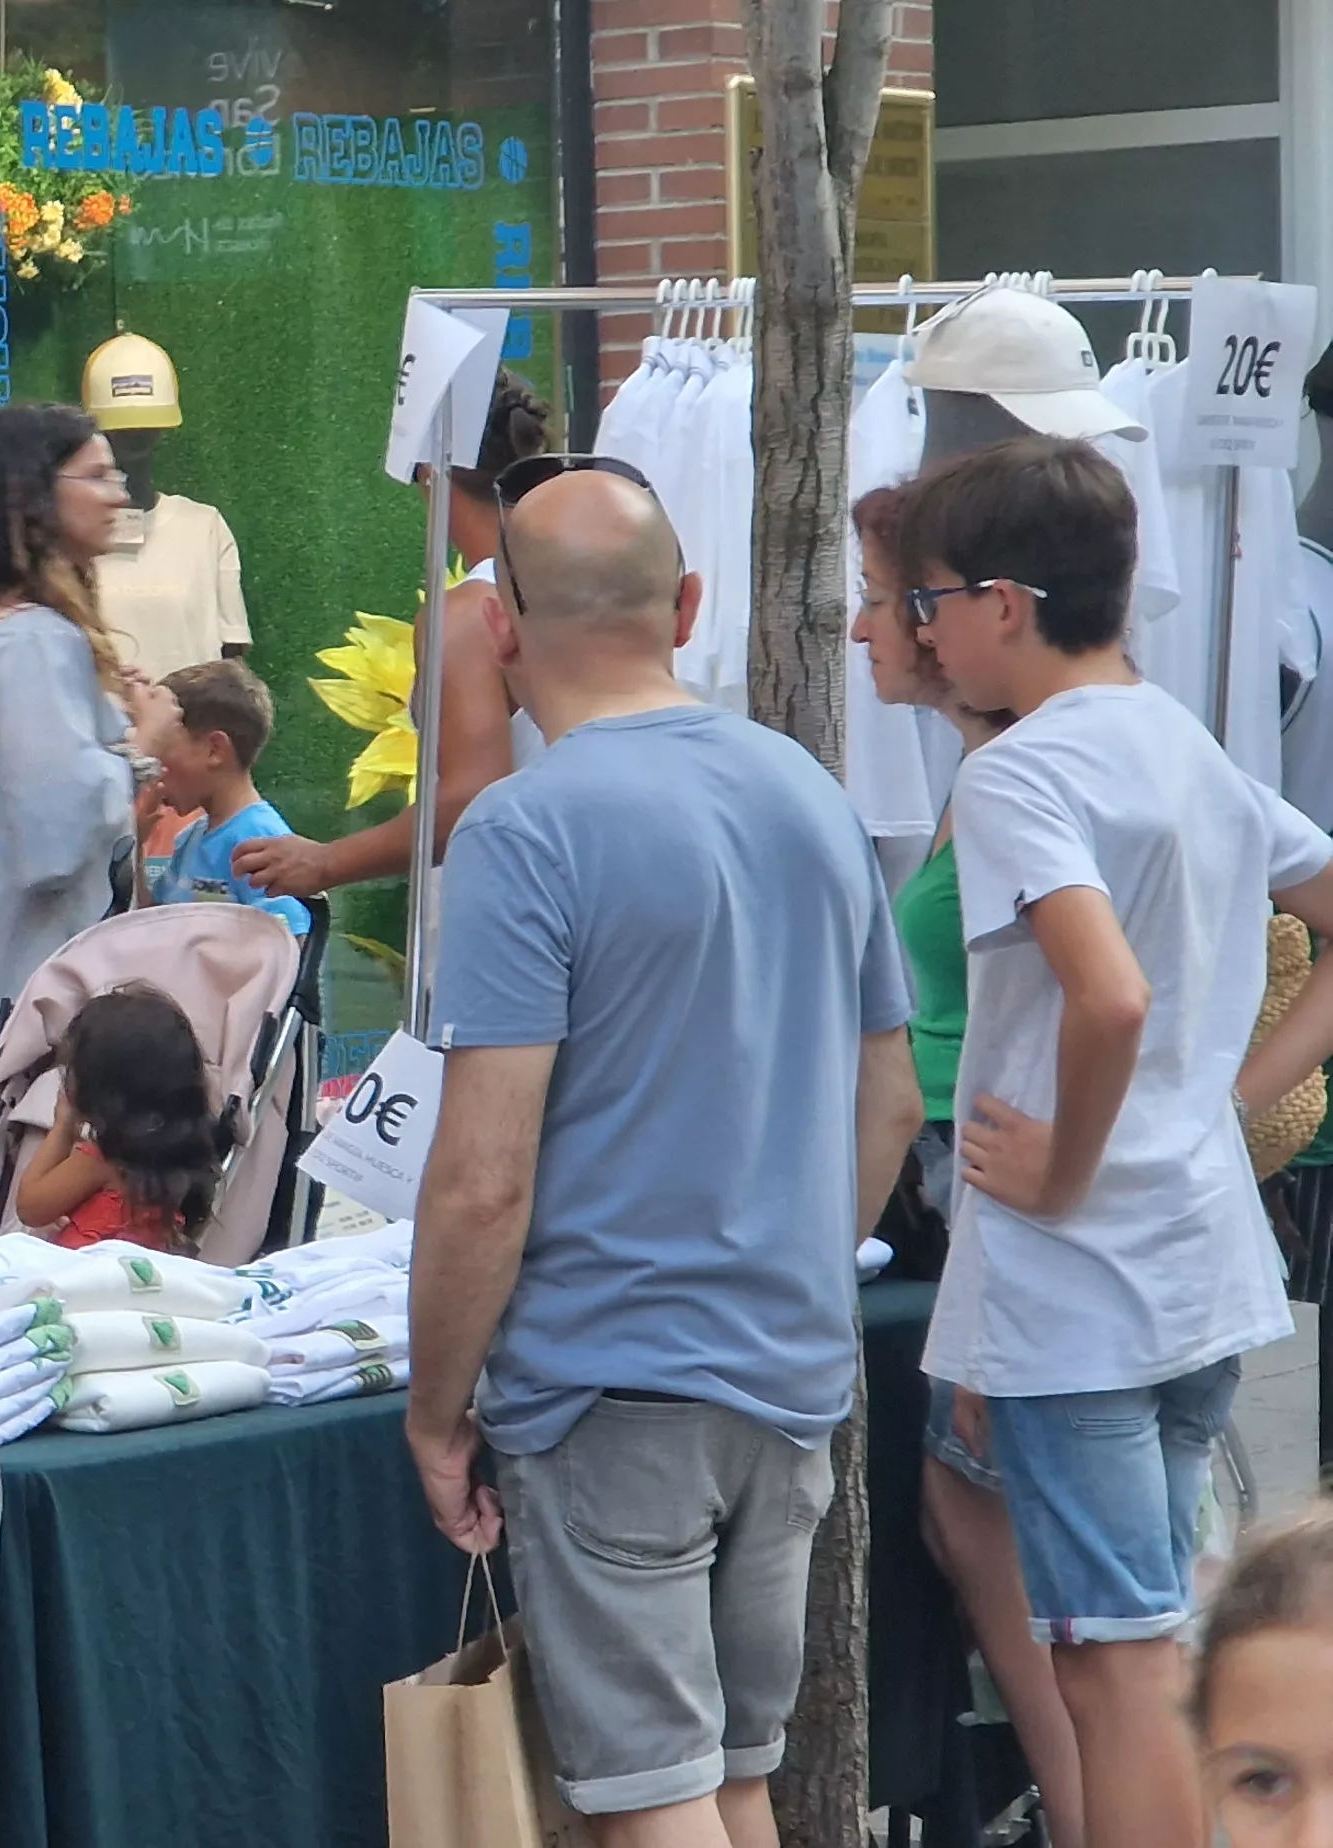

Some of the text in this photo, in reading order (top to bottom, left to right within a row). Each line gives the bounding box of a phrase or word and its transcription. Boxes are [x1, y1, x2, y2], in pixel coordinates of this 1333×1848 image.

[20, 100, 224, 176] REBAJAS
[293, 112, 485, 190] REBAJAS
[1215, 333, 1281, 398] 20€
[345, 1072, 418, 1146] 0€
